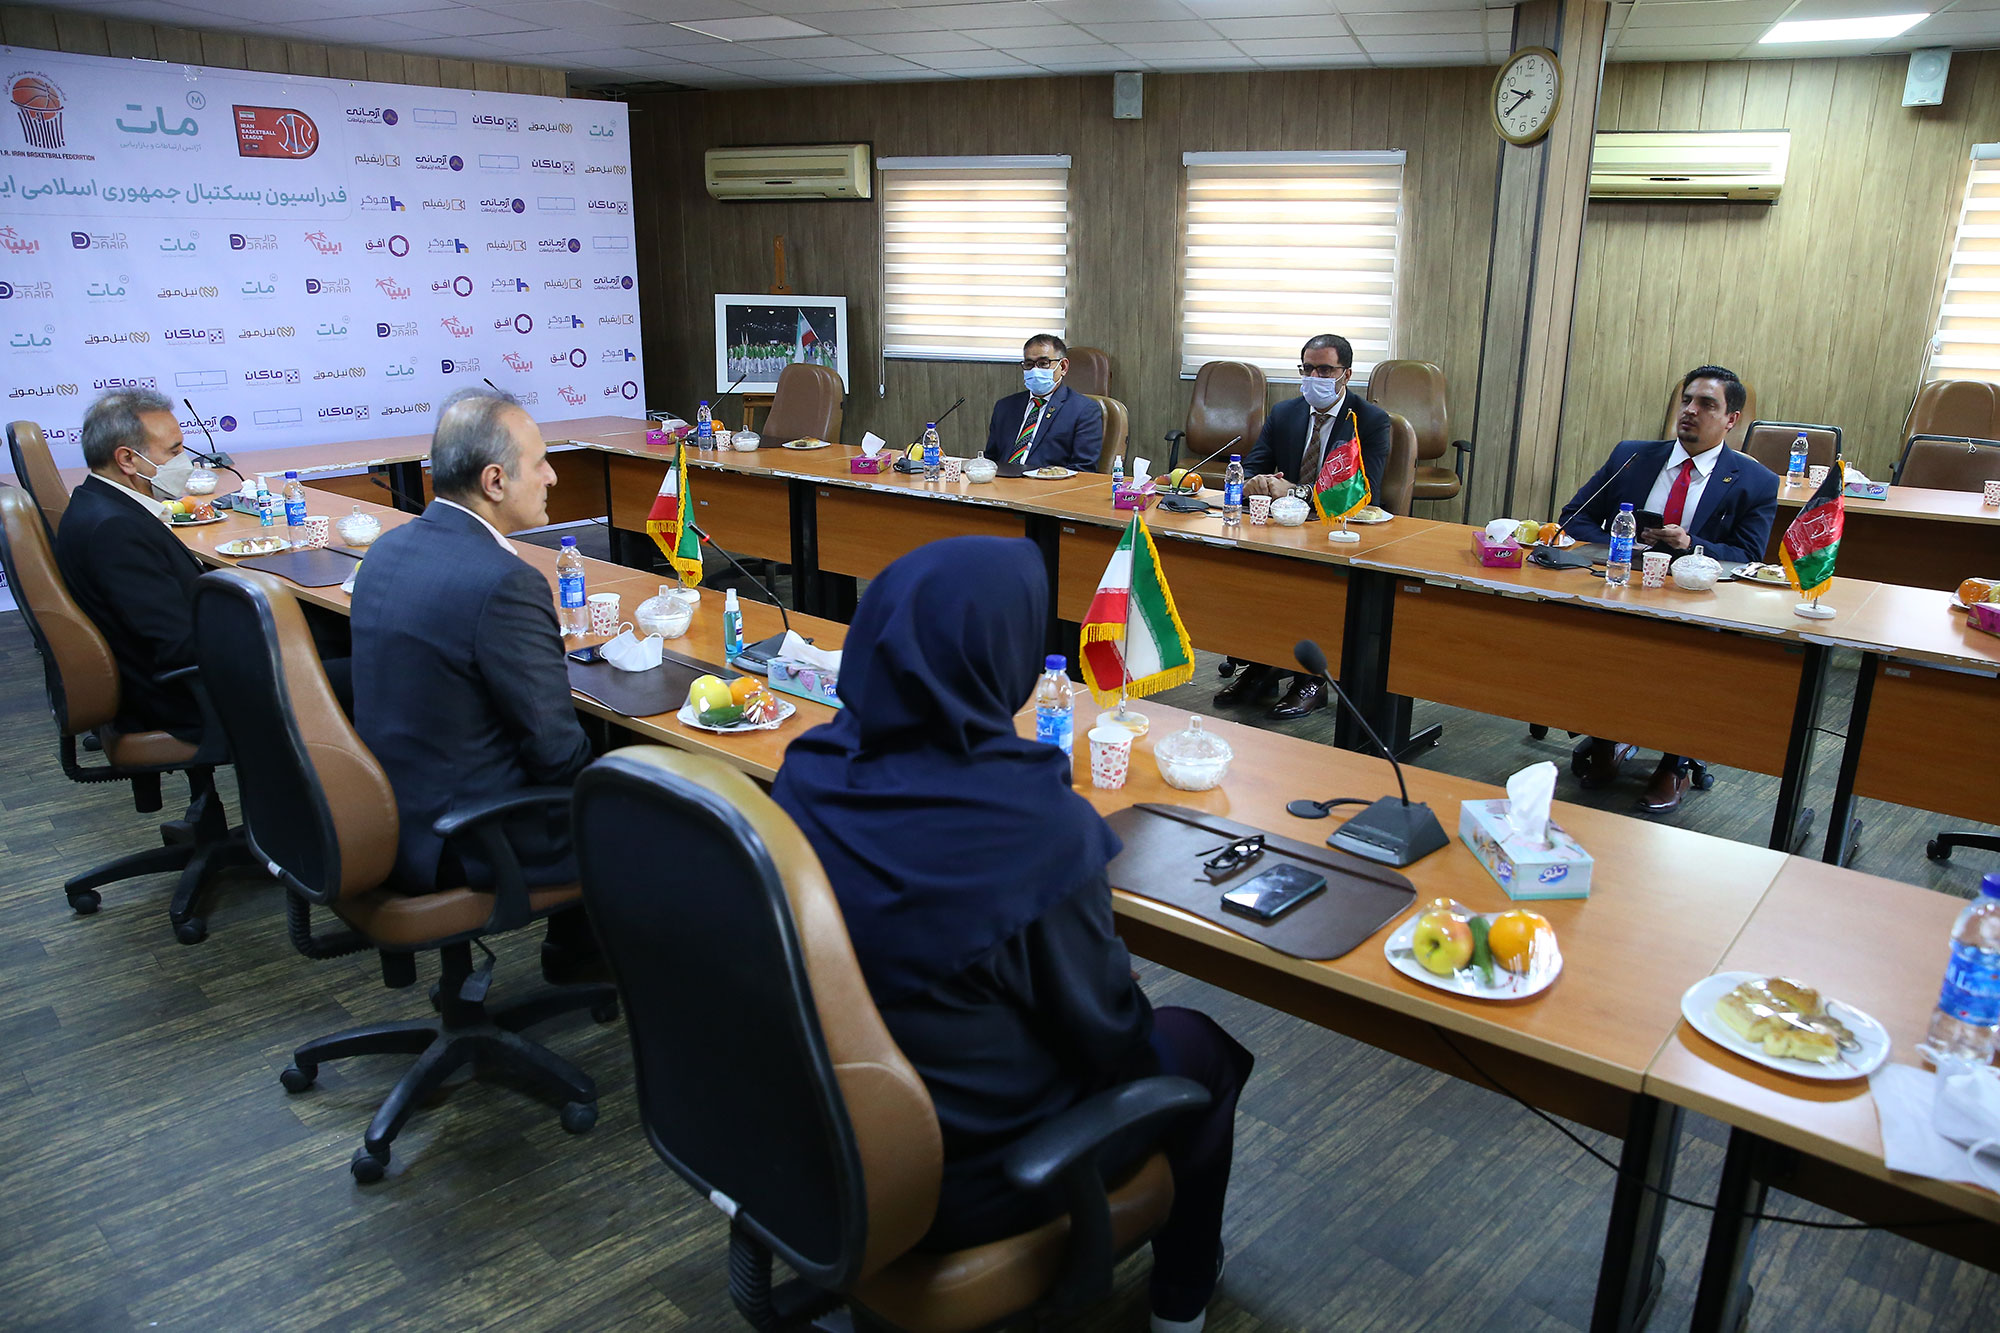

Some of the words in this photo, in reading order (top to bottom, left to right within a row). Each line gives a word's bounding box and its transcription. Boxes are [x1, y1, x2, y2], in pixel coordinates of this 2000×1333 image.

[116, 104, 199, 136] مات
[473, 115, 504, 126] ماکان
[589, 124, 613, 137] مات
[27, 151, 62, 159] BASKETBALL
[62, 153, 95, 161] FEDERATION
[531, 159, 561, 169] ماکان
[22, 177, 97, 200] اسلامی
[102, 185, 181, 203] جمهوری
[186, 183, 261, 206] بسکتبال
[266, 185, 347, 207] فدراسیون
[588, 200, 616, 209] ماکان
[160, 238, 196, 251] مات
[365, 239, 385, 250] افق
[87, 283, 125, 296] مات
[241, 281, 275, 294] مات
[431, 280, 450, 291] افق
[494, 317, 511, 329] افق
[164, 329, 206, 339] ماکان
[316, 323, 347, 336] مات
[10, 333, 52, 347] مات
[550, 352, 567, 363] افق
[245, 370, 283, 380] ماکان
[385, 364, 414, 376] مات
[93, 378, 137, 389] ماکان
[603, 385, 620, 396] افق
[318, 407, 353, 417] ماکان
[42, 429, 65, 439] ماک
[823, 684, 837, 696] Ten
[1538, 863, 1568, 884] تنو
